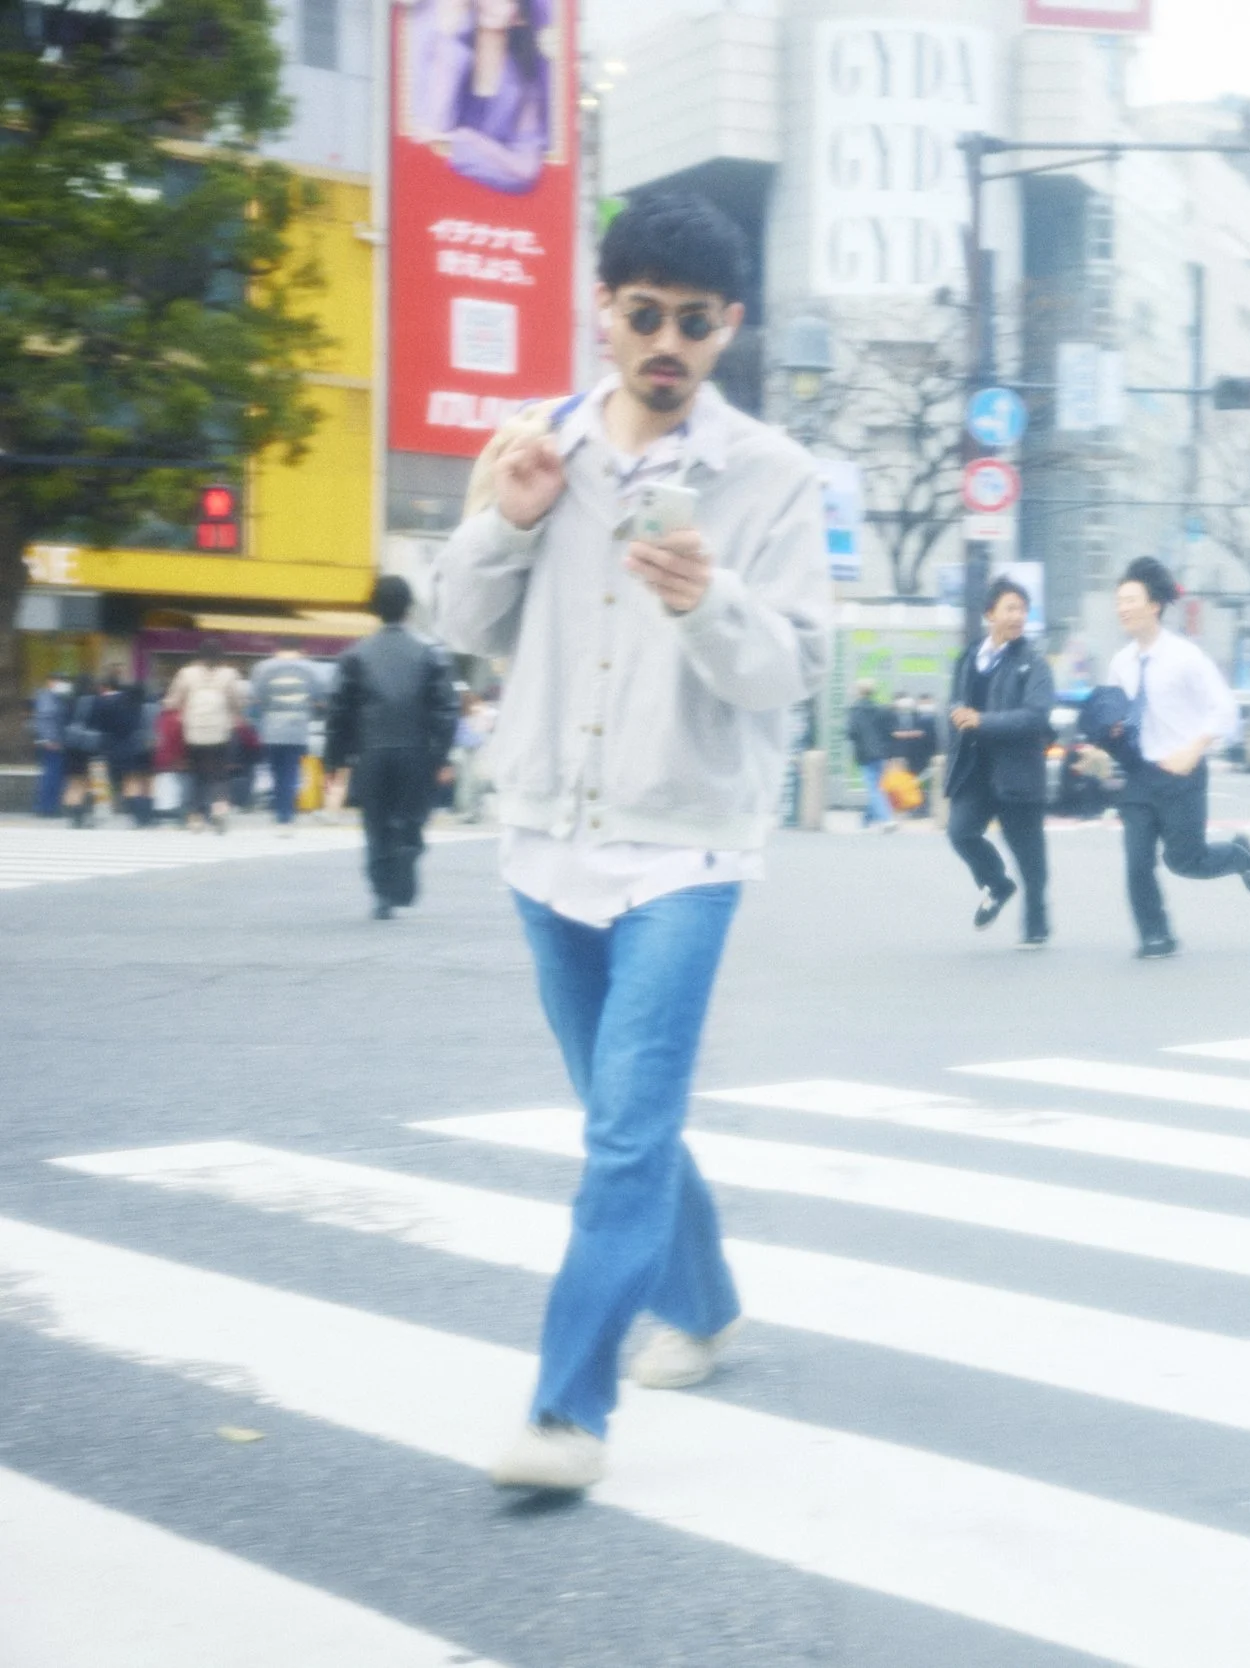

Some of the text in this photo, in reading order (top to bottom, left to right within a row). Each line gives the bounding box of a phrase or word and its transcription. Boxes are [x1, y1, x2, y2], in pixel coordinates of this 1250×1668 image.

[828, 29, 980, 105] GYDA
[827, 123, 970, 195] GYD
[826, 216, 968, 285] GYD
